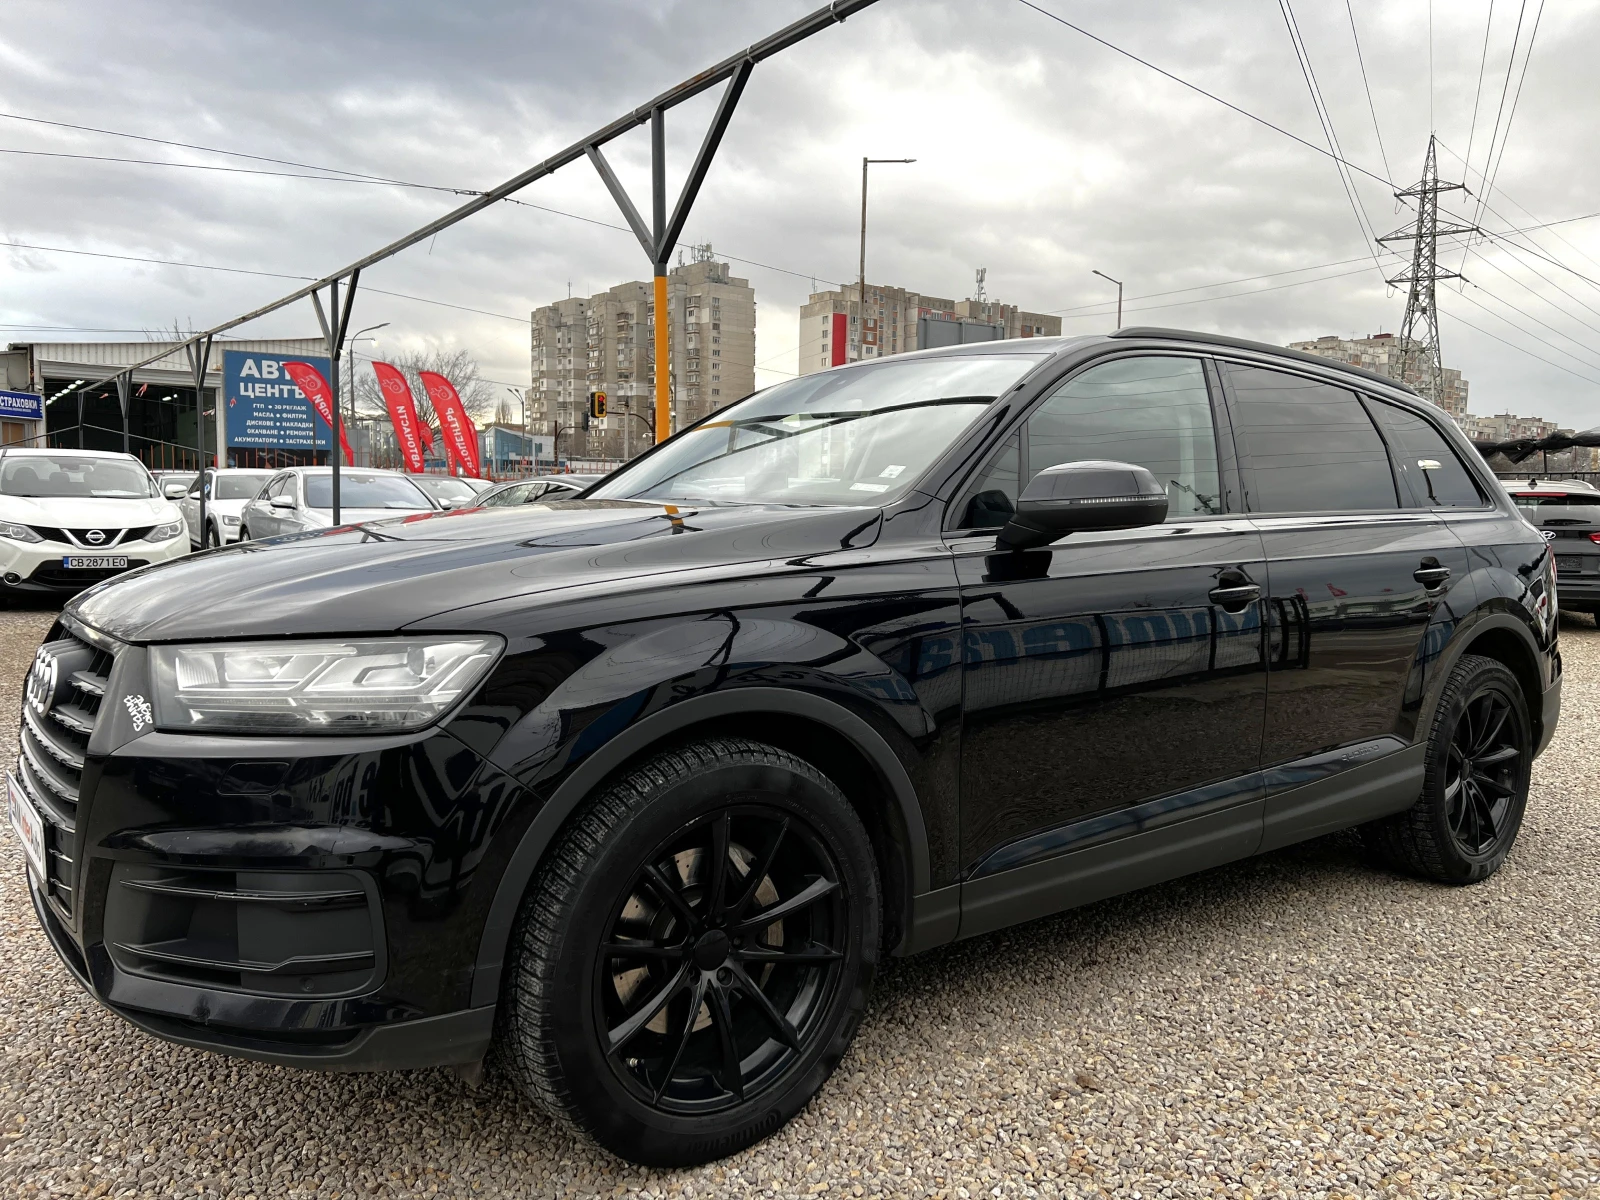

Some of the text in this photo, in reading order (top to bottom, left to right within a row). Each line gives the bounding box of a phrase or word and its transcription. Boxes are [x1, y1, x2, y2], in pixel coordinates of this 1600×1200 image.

[240, 358, 313, 381] АВТ
[240, 382, 307, 399] ЦЕНТЪ
[246, 419, 314, 429] ДИСКОВЕ НАКЛАДКИ
[234, 436, 278, 444] АКУМУЛАТОРИ
[70, 558, 85, 568] CB
[85, 558, 110, 568] 2871
